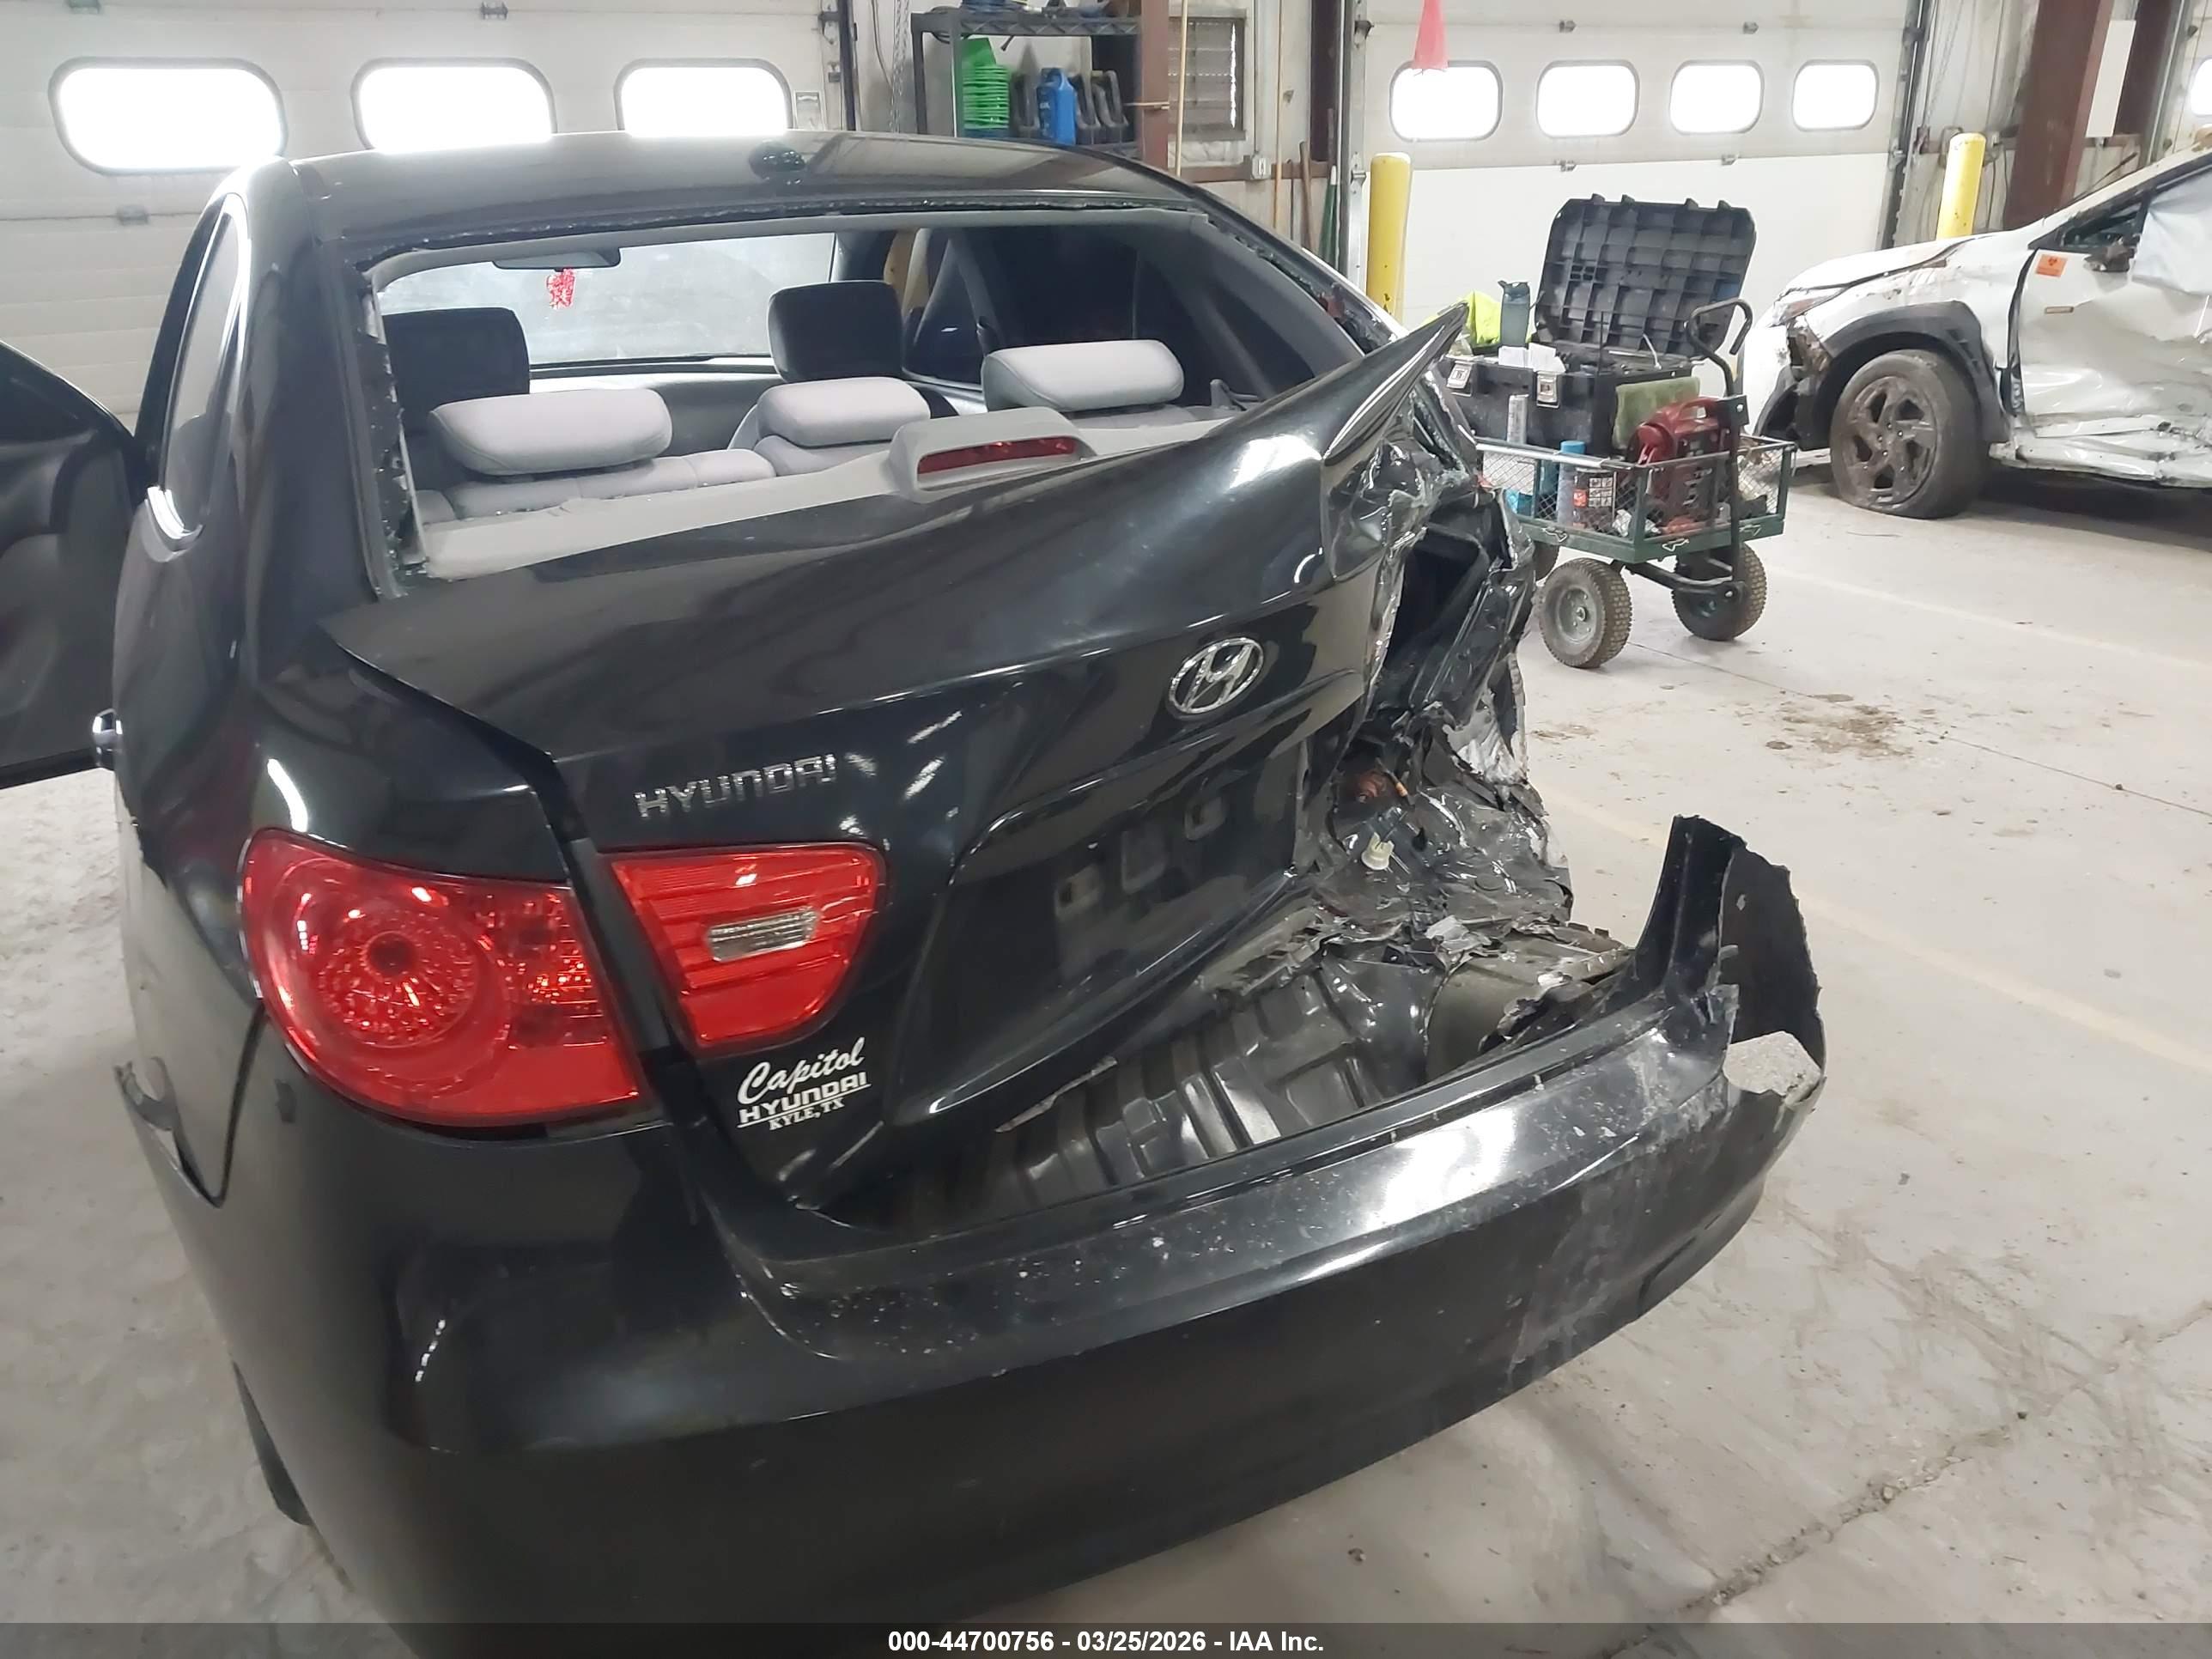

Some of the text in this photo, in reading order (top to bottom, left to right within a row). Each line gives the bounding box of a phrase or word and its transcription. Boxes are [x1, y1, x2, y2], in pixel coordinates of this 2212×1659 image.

[633, 754, 836, 817] HYUNDAI
[737, 1036, 866, 1104] Capitol
[738, 1072, 867, 1124] HYUNDAI
